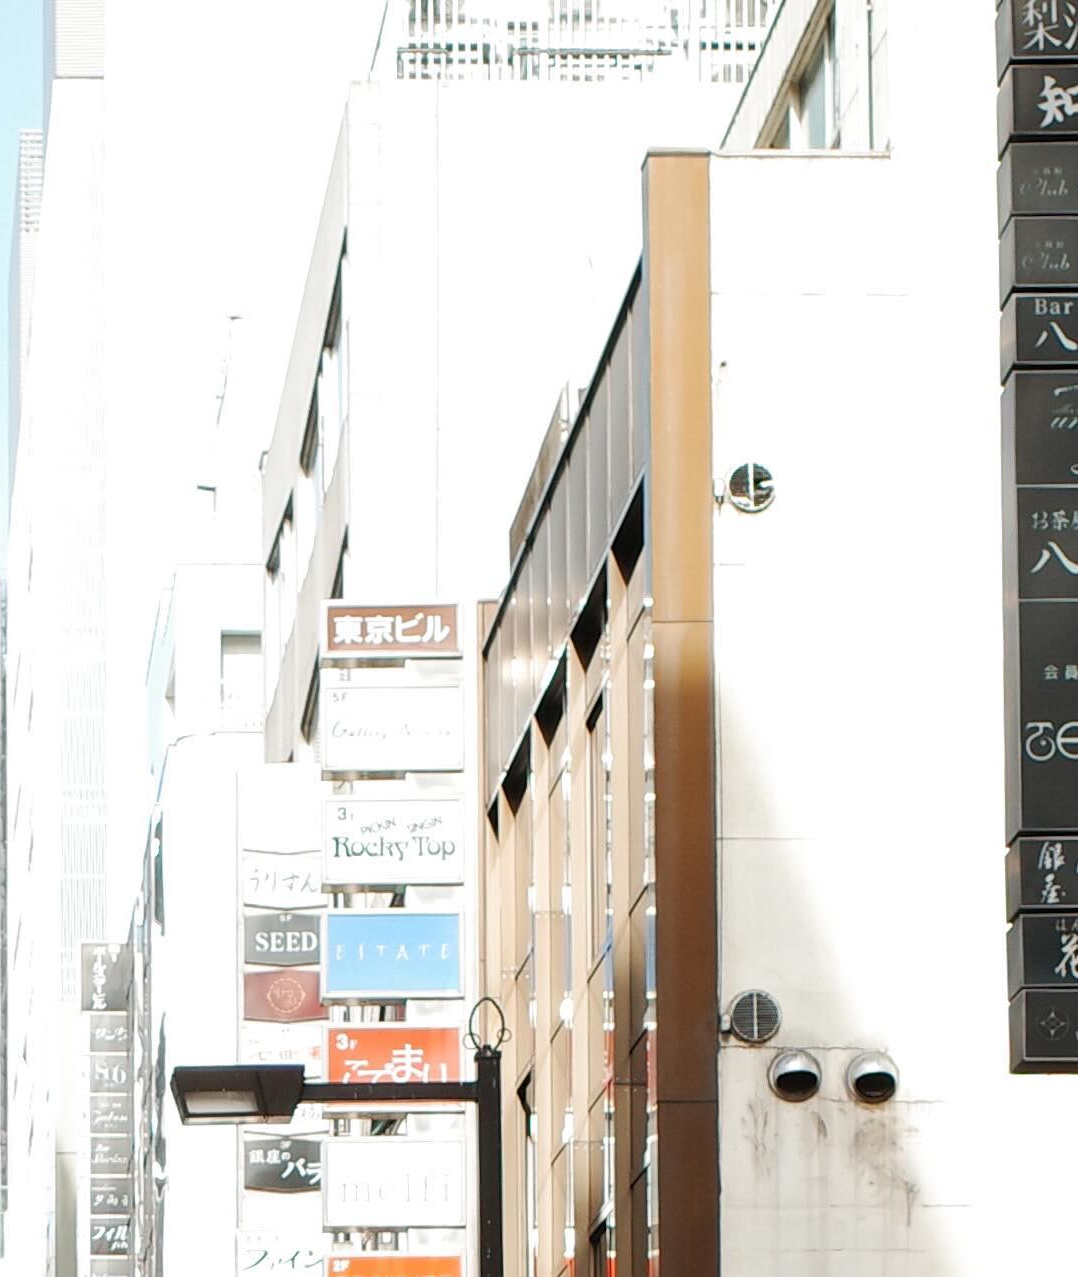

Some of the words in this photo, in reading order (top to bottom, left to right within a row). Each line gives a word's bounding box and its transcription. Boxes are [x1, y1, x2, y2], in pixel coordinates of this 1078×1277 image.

[1035, 298, 1073, 315] Bar
[333, 612, 450, 644] 東京ビル
[332, 836, 406, 862] Rocky
[411, 836, 455, 861] Top
[255, 931, 318, 953] SEED
